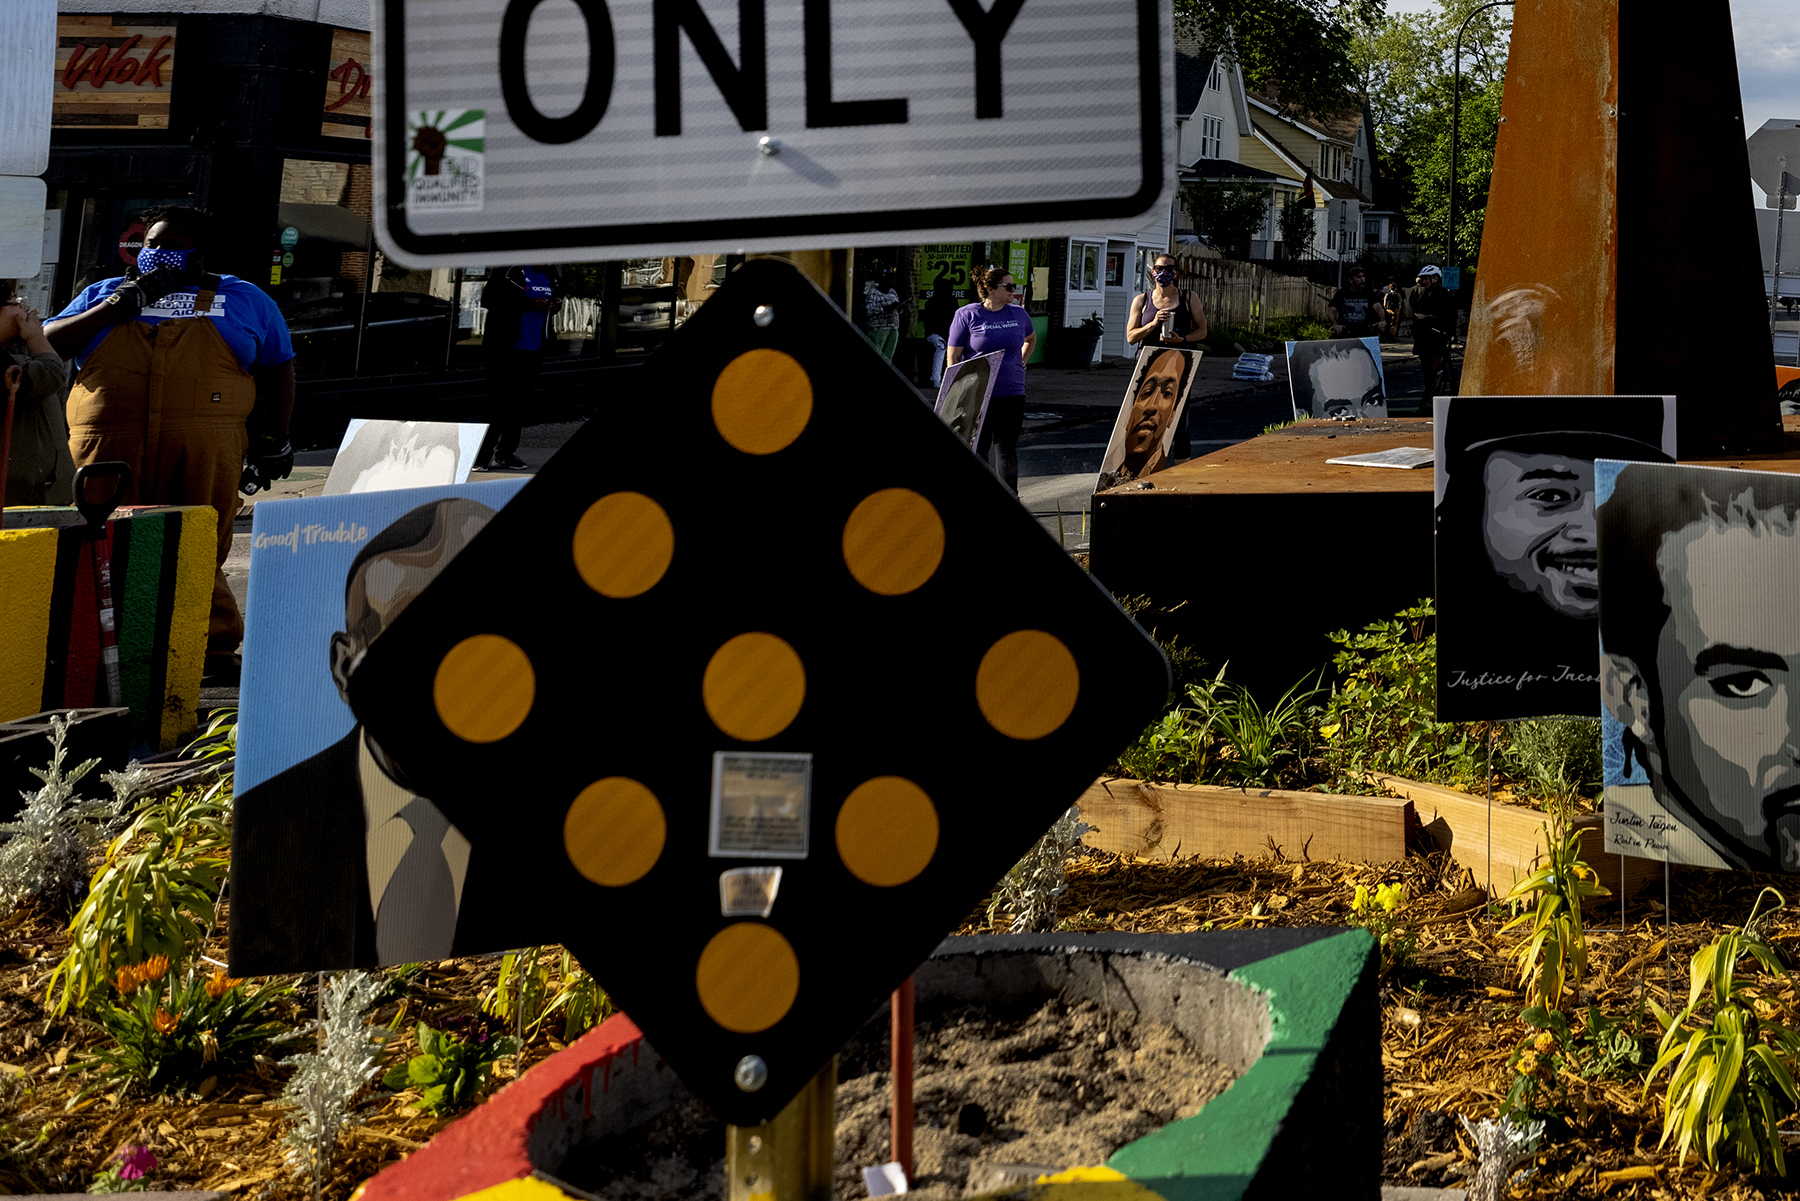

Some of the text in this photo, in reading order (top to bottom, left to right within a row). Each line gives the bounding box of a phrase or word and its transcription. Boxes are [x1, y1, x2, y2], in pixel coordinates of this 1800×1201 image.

[61, 33, 172, 89] Wok
[924, 244, 972, 253] UNLIMITED
[926, 260, 966, 286] $25
[254, 521, 368, 553] Good Trouble
[1447, 670, 1516, 690] Justice
[1515, 671, 1548, 691] for
[1609, 811, 1644, 828] Justin
[1613, 833, 1632, 846] Rest
